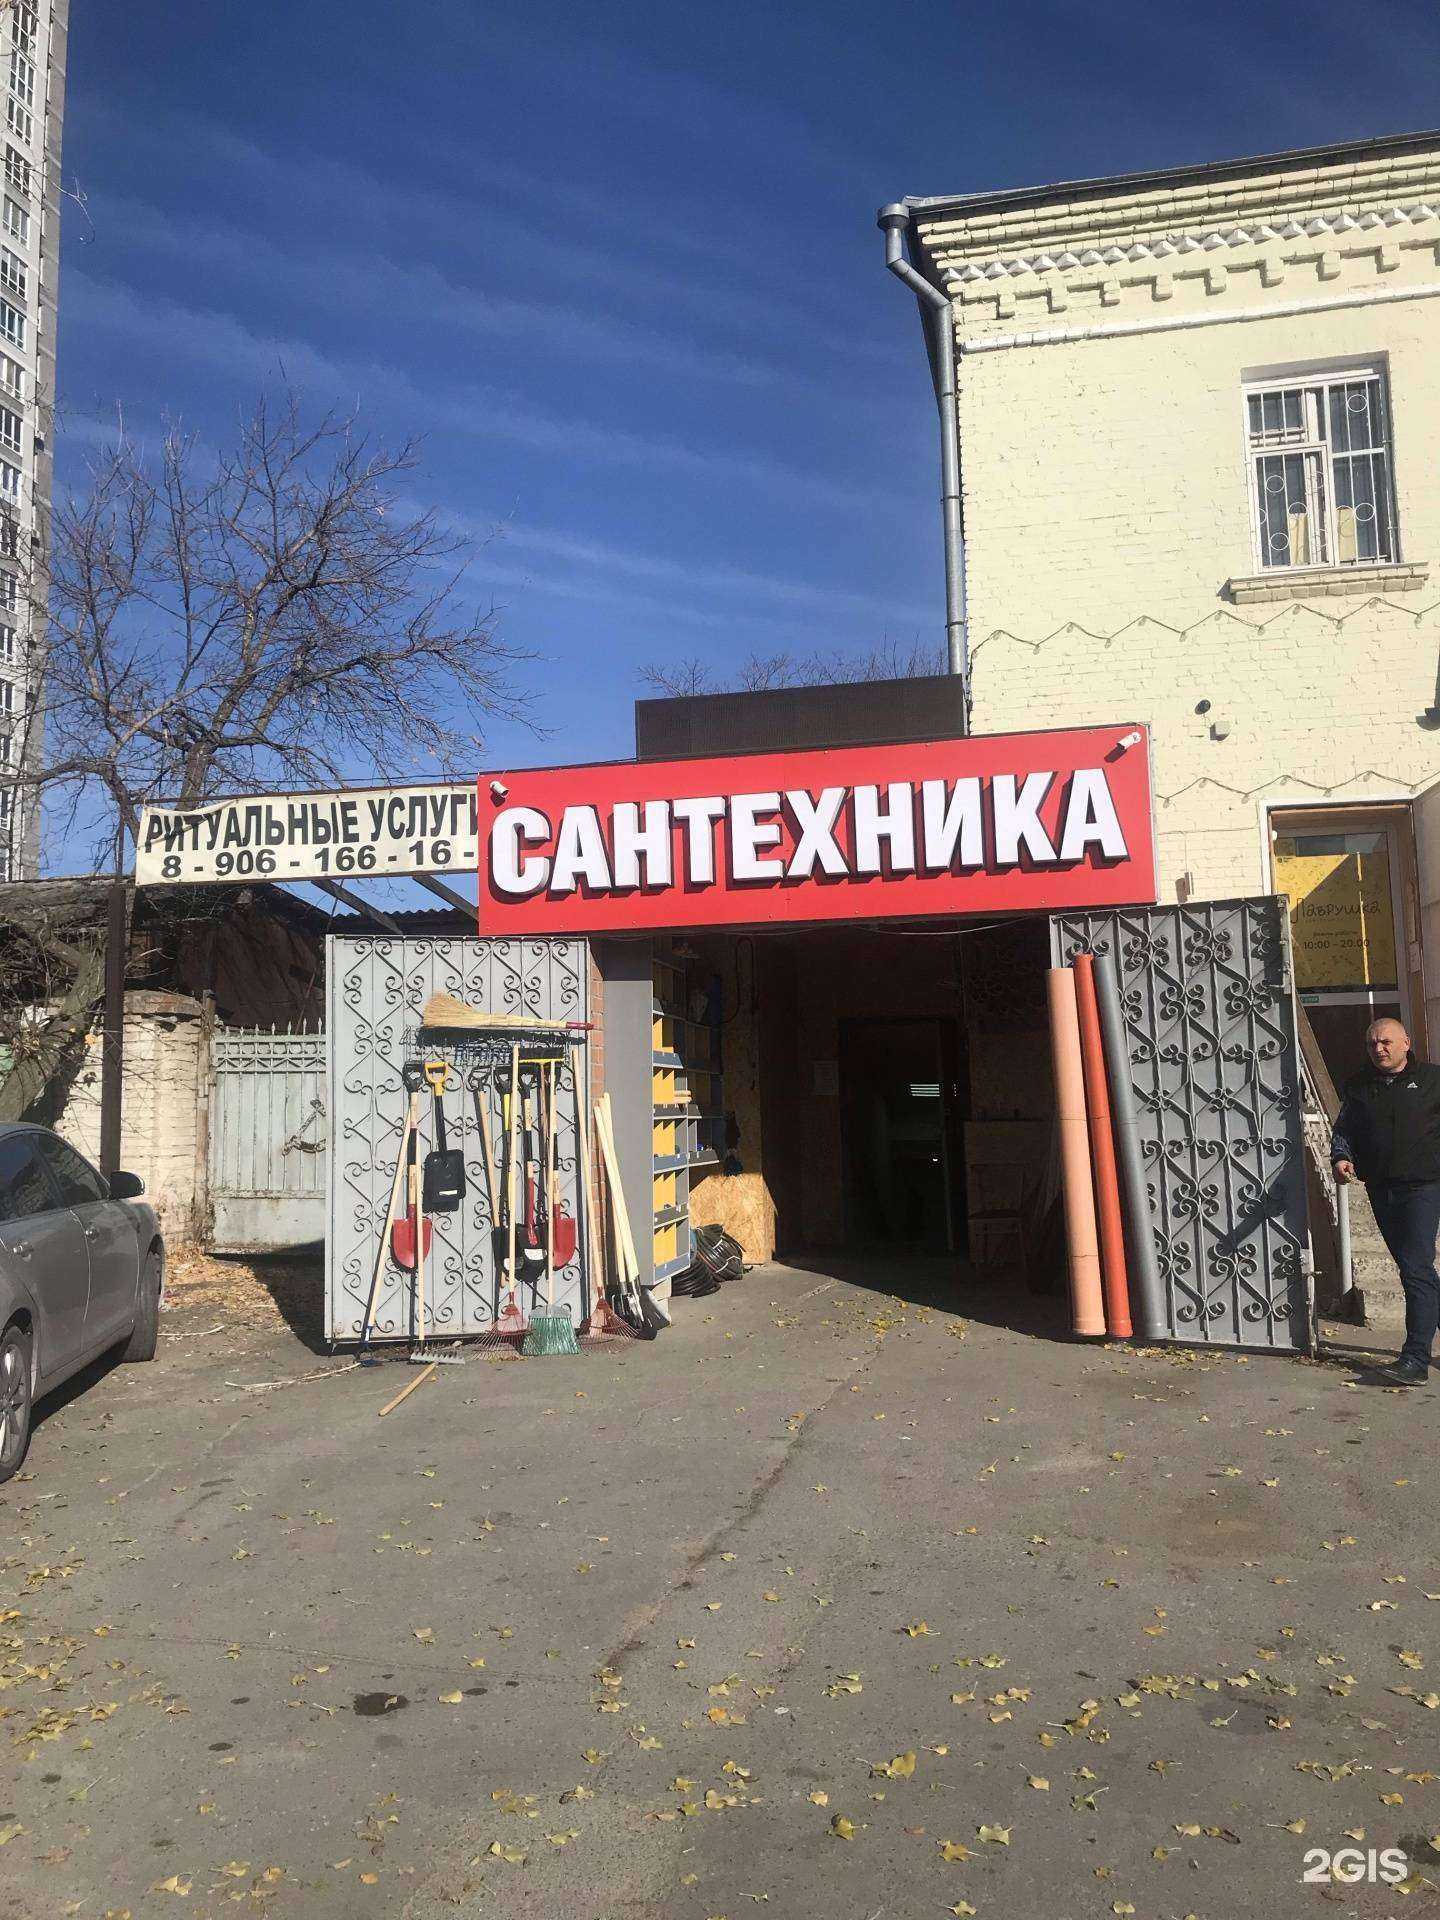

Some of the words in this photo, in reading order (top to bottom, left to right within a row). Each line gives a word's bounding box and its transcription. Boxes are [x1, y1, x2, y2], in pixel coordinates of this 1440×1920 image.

[145, 801, 360, 854] РИТУАЛЬНЫЕ
[491, 767, 1128, 894] САНТЕХНИКА
[1290, 898, 1381, 924] Лаврушка
[1303, 940, 1330, 950] 10:00
